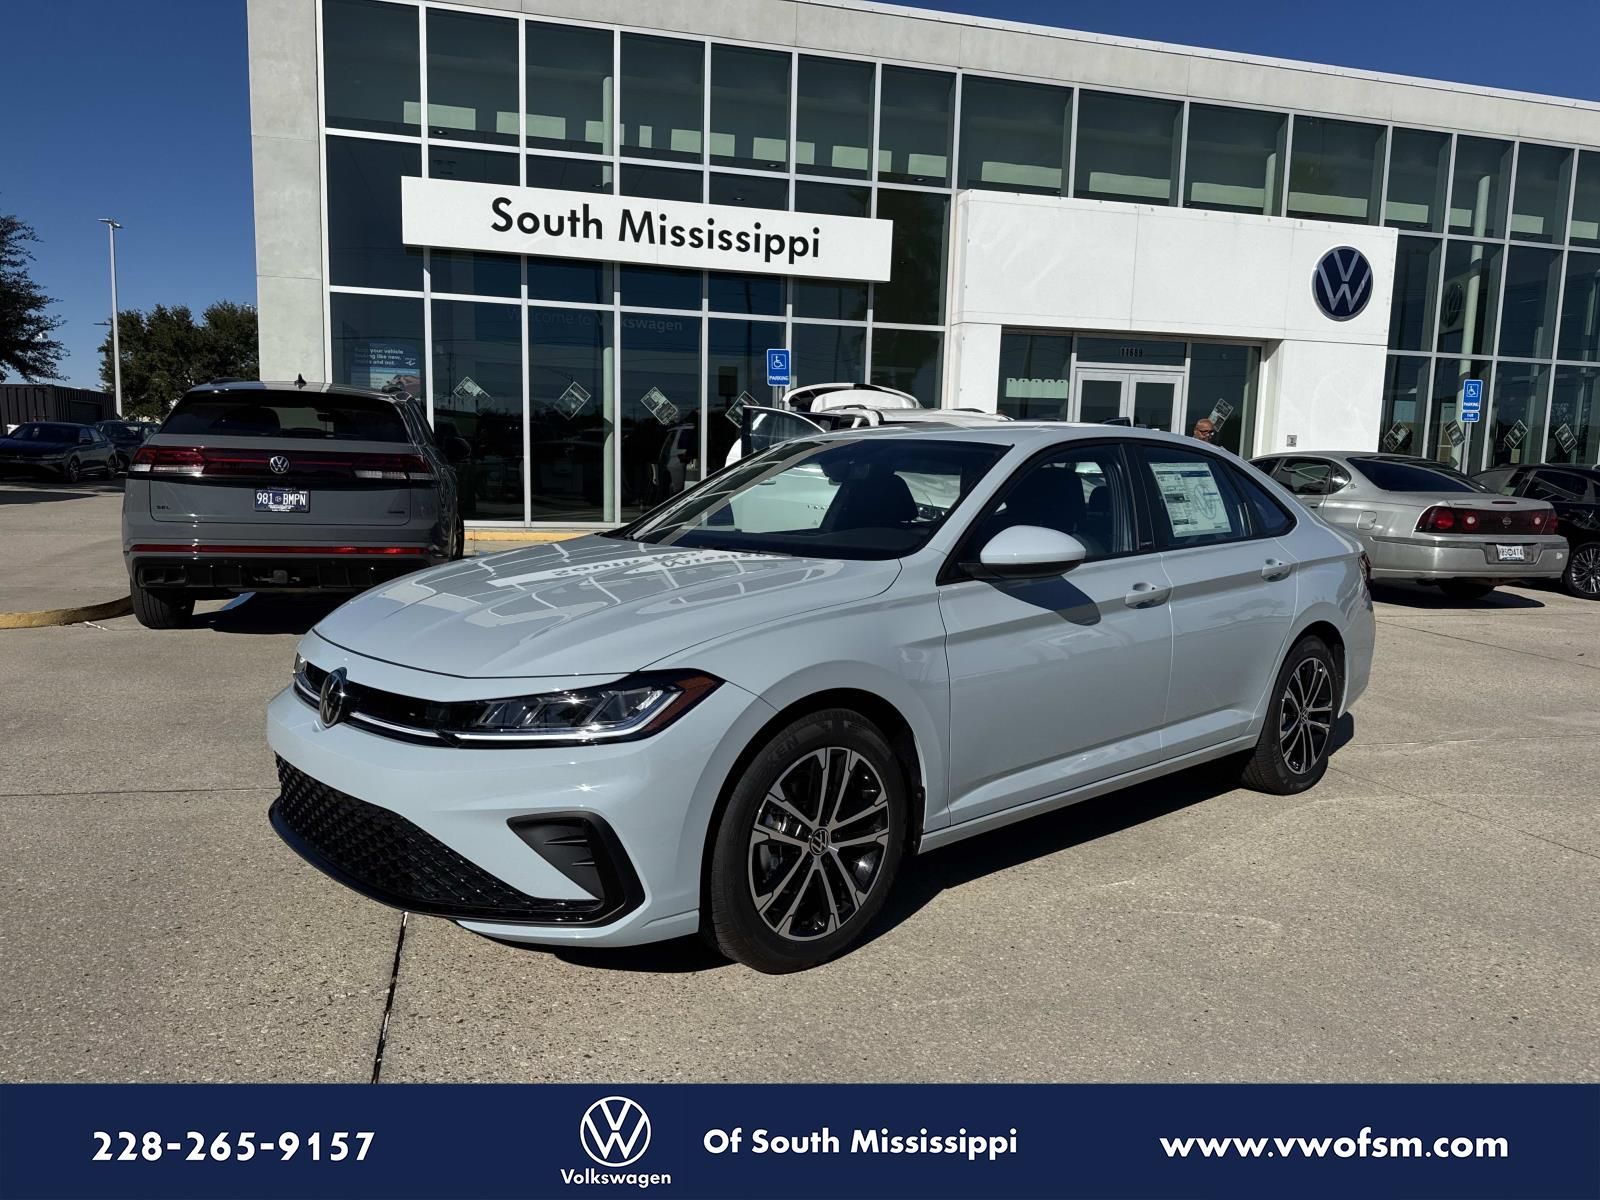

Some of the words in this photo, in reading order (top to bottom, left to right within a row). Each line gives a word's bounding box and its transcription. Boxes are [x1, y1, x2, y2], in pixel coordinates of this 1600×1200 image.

[490, 197, 603, 239] South
[618, 208, 820, 264] Mississippi
[506, 307, 574, 326] Wlcome
[594, 313, 683, 333] Vkswagen
[256, 492, 274, 505] 981
[282, 493, 306, 506] BMPN
